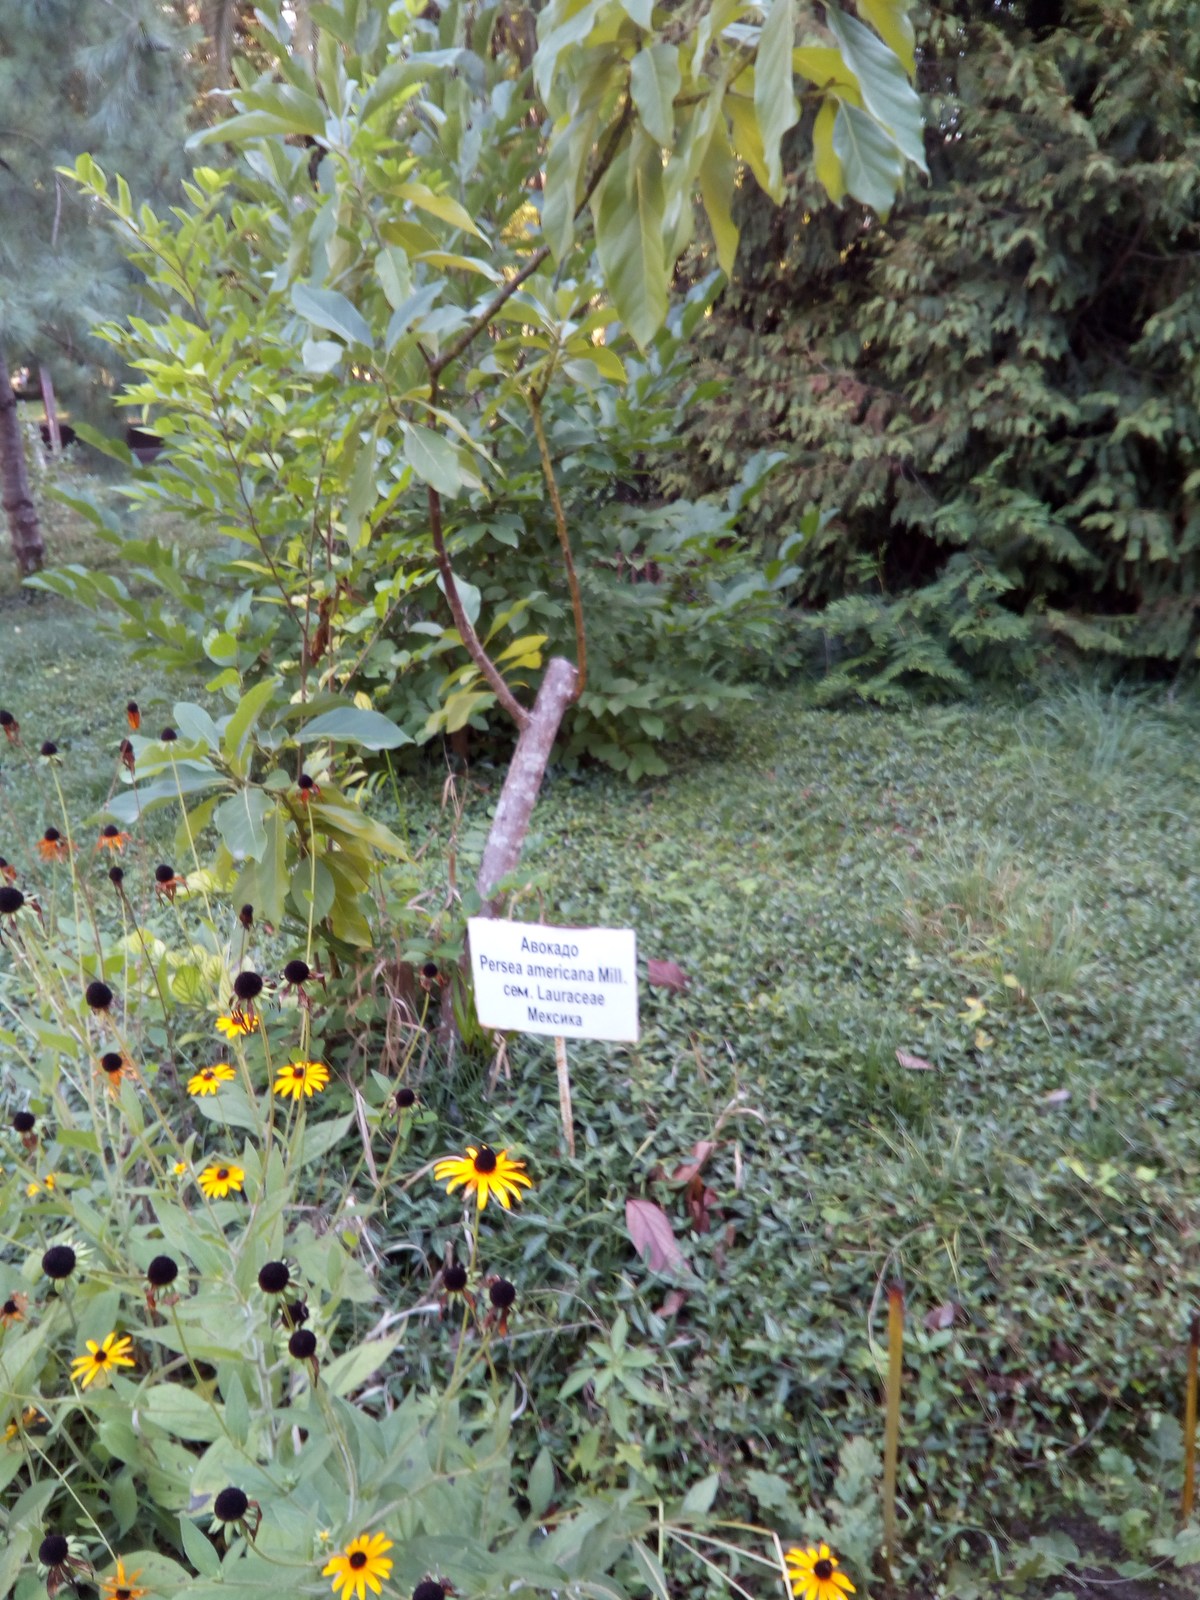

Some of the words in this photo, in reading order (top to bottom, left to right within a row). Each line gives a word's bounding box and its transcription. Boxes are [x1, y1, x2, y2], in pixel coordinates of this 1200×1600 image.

[521, 937, 579, 959] Авокадо
[479, 955, 522, 975] Persea
[527, 963, 594, 982] americana
[598, 967, 628, 985] Mill.
[503, 983, 533, 999] сем.
[537, 985, 605, 1006] Lauraceae
[527, 1006, 582, 1027] Мексика
